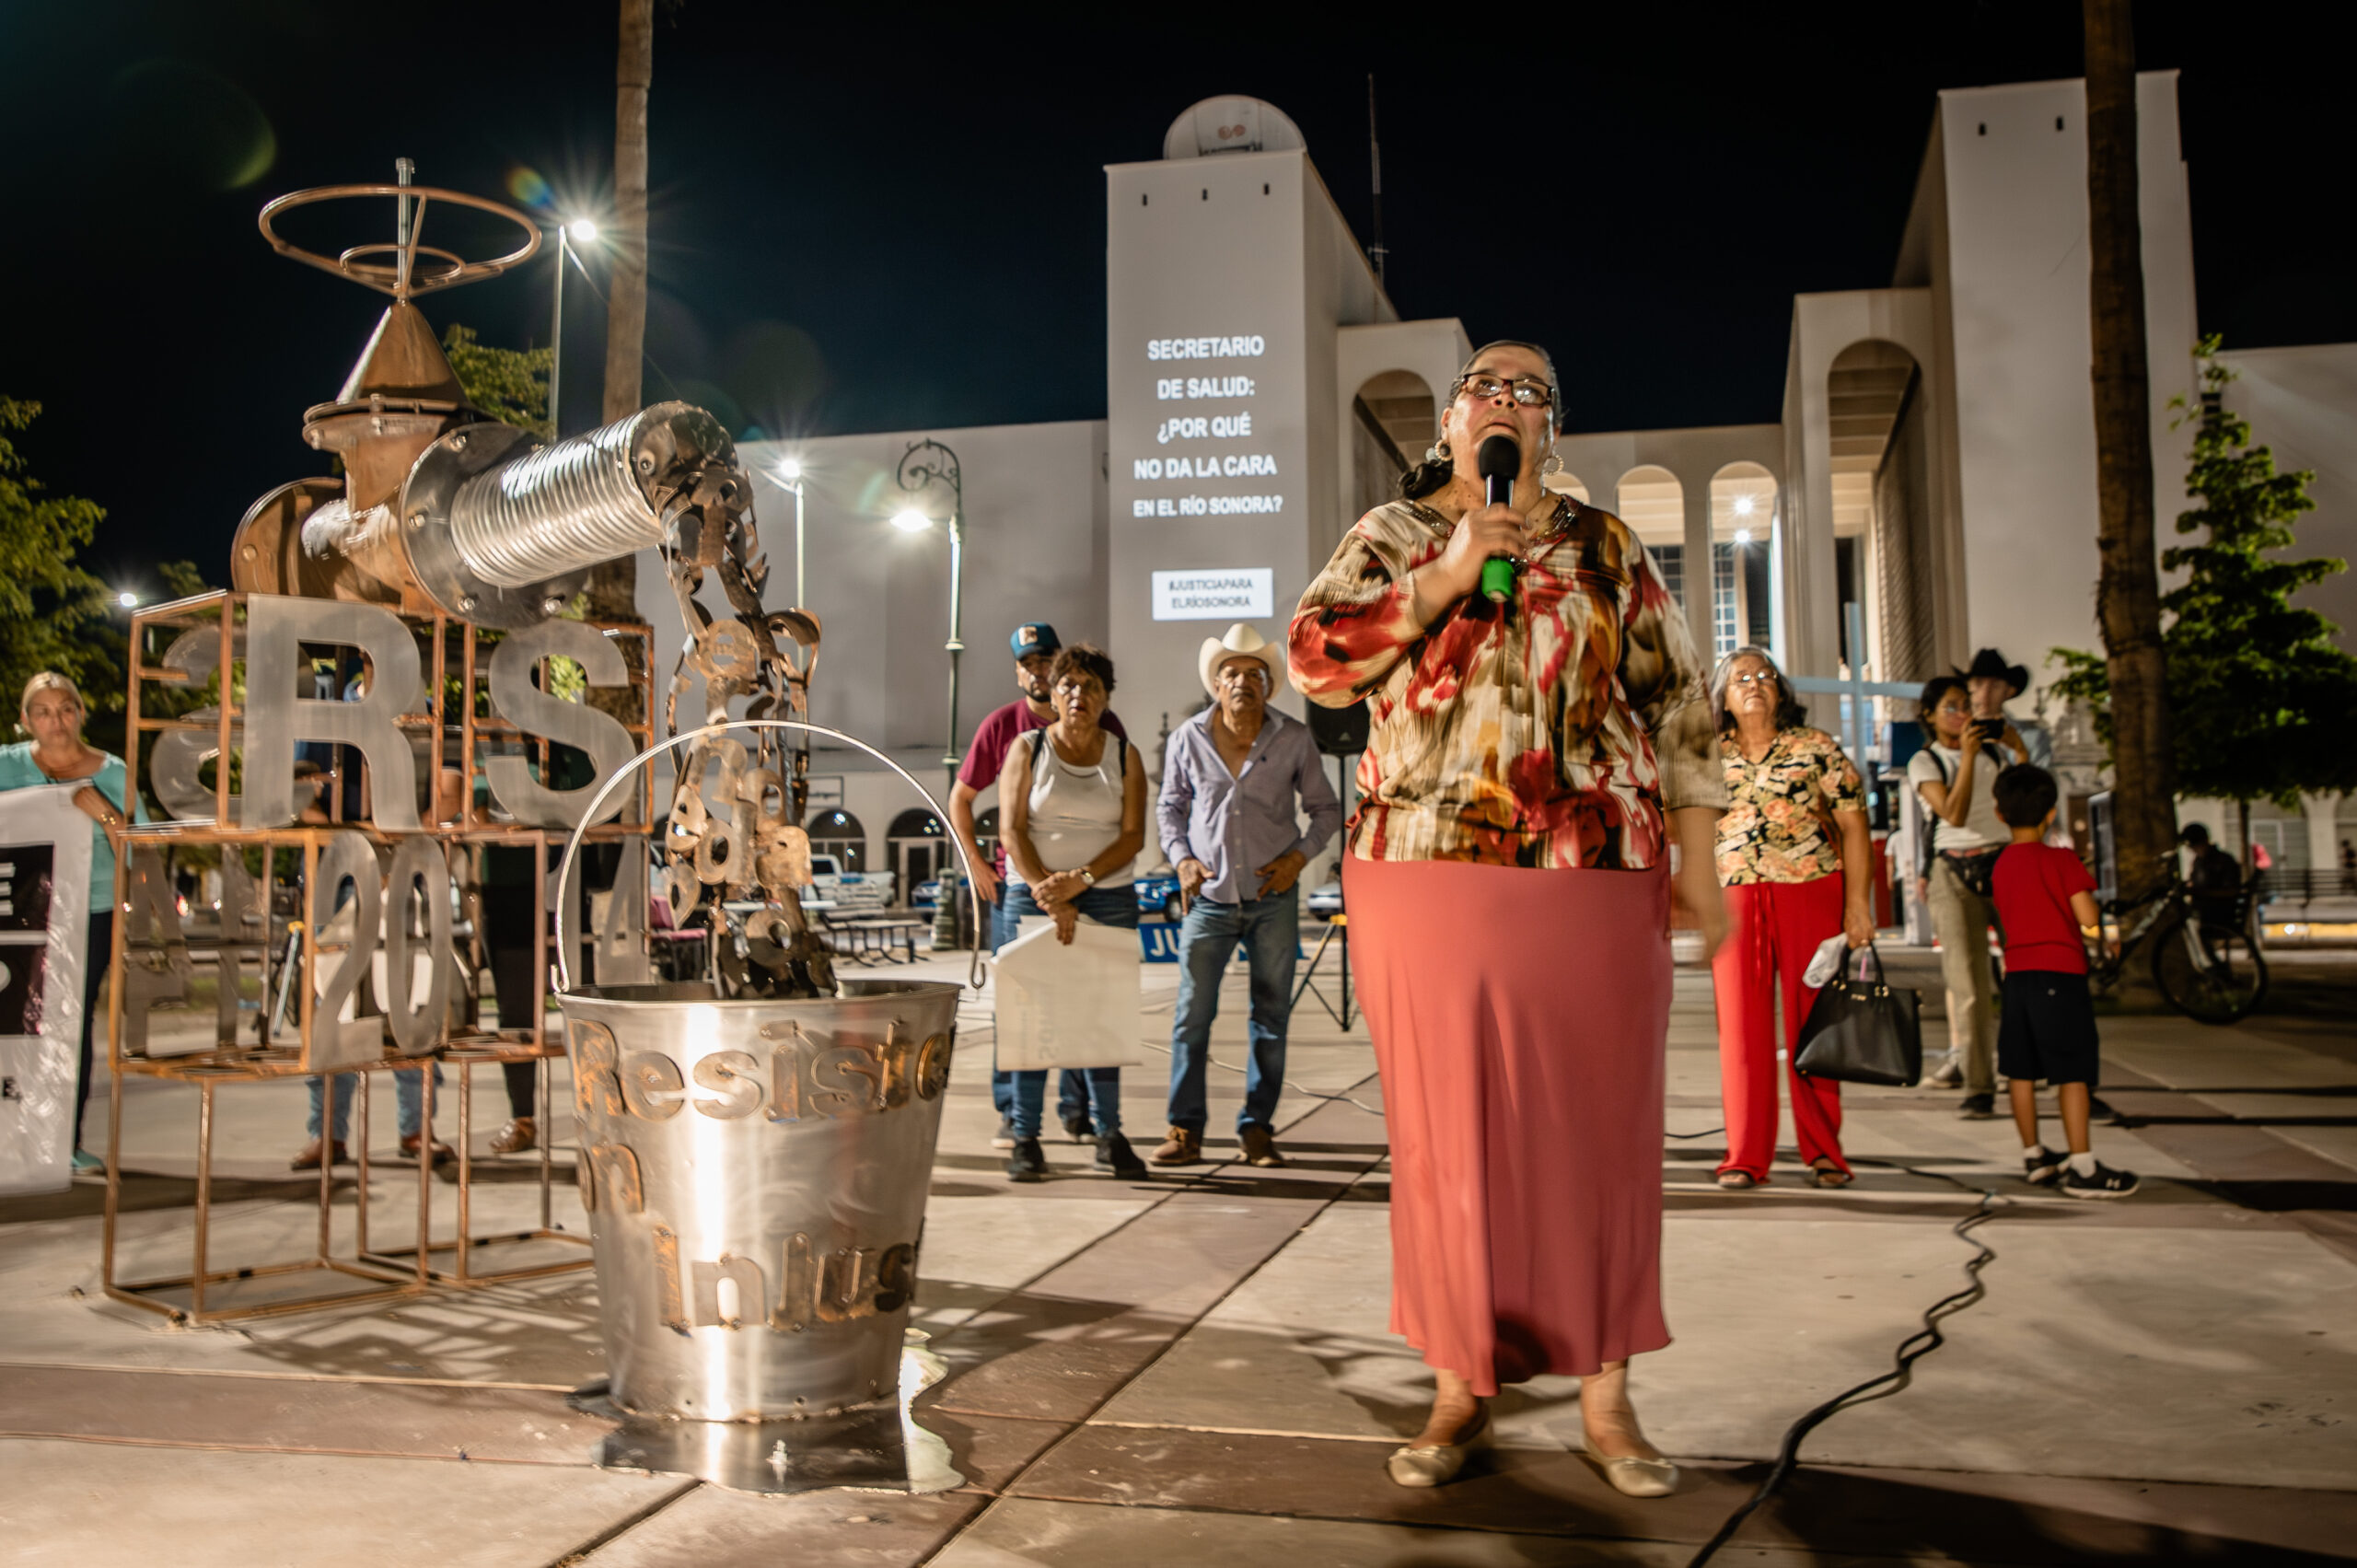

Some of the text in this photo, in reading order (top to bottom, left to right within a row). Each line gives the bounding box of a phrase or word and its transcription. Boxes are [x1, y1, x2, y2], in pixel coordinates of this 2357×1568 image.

[1147, 335, 1265, 360] SECRETARIO
[1157, 376, 1255, 400] DE SALUD:
[1157, 412, 1251, 444] ¿POR QUÉ
[1134, 455, 1277, 480] NO DA LA CARA
[1133, 494, 1283, 517] EN EL RÍO SONORA?
